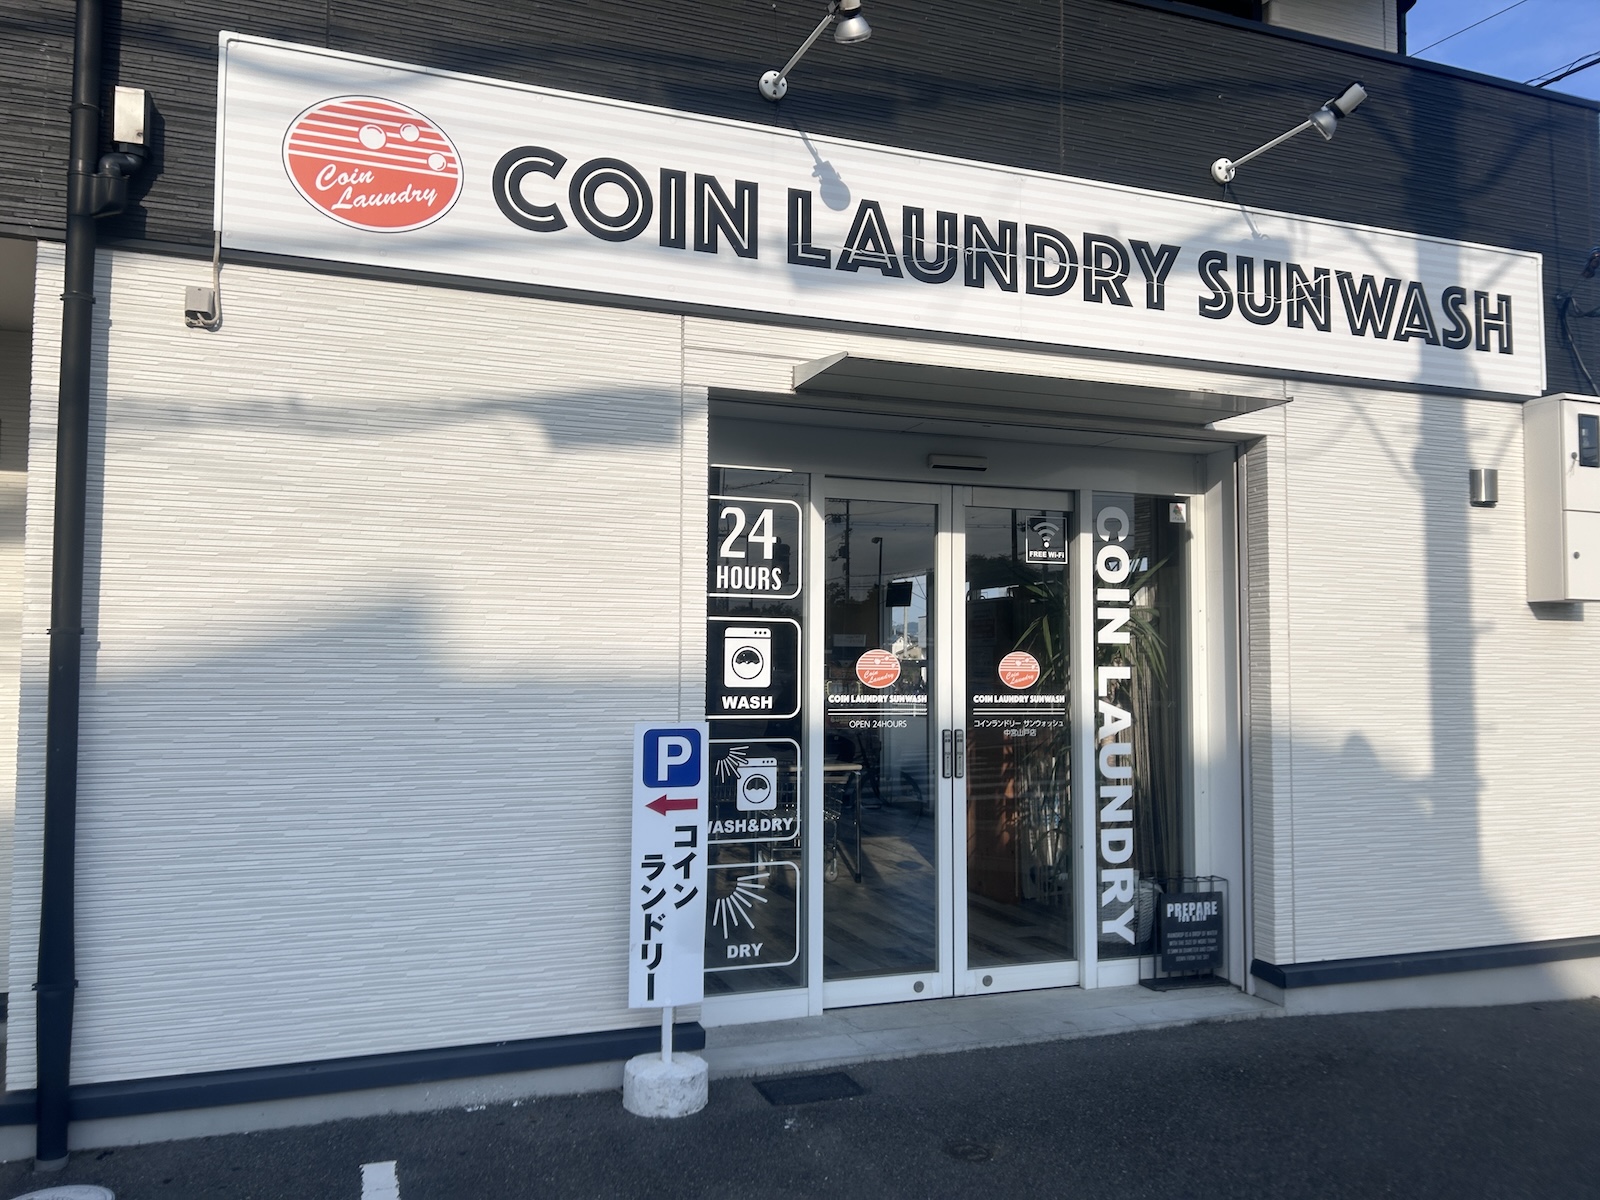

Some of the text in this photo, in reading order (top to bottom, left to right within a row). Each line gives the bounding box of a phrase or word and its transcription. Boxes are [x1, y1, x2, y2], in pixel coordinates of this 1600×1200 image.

[315, 164, 375, 191] Coin
[331, 183, 438, 210] Laundry
[492, 145, 1514, 355] COIN LAUNDRY SUNWASH
[719, 506, 777, 560] 24
[1029, 550, 1065, 559] FREE Wi-Fi
[716, 565, 782, 591] HOURS
[722, 695, 773, 710] WASH
[828, 694, 928, 703] COIN LAUNDRY SUNWASH
[972, 694, 1066, 703] COIN LAUNDRY SUNWASH
[849, 720, 871, 728] OPEN
[872, 720, 908, 728] 24HOURS
[973, 720, 1022, 728] コインランドリー
[1096, 506, 1136, 946] COIN LAUNDRY
[708, 817, 794, 834] ASH&DRY
[672, 824, 699, 910] コイン
[1166, 901, 1218, 918] PREPARE
[640, 853, 667, 1001] ランドリー
[726, 942, 764, 959] DRY
